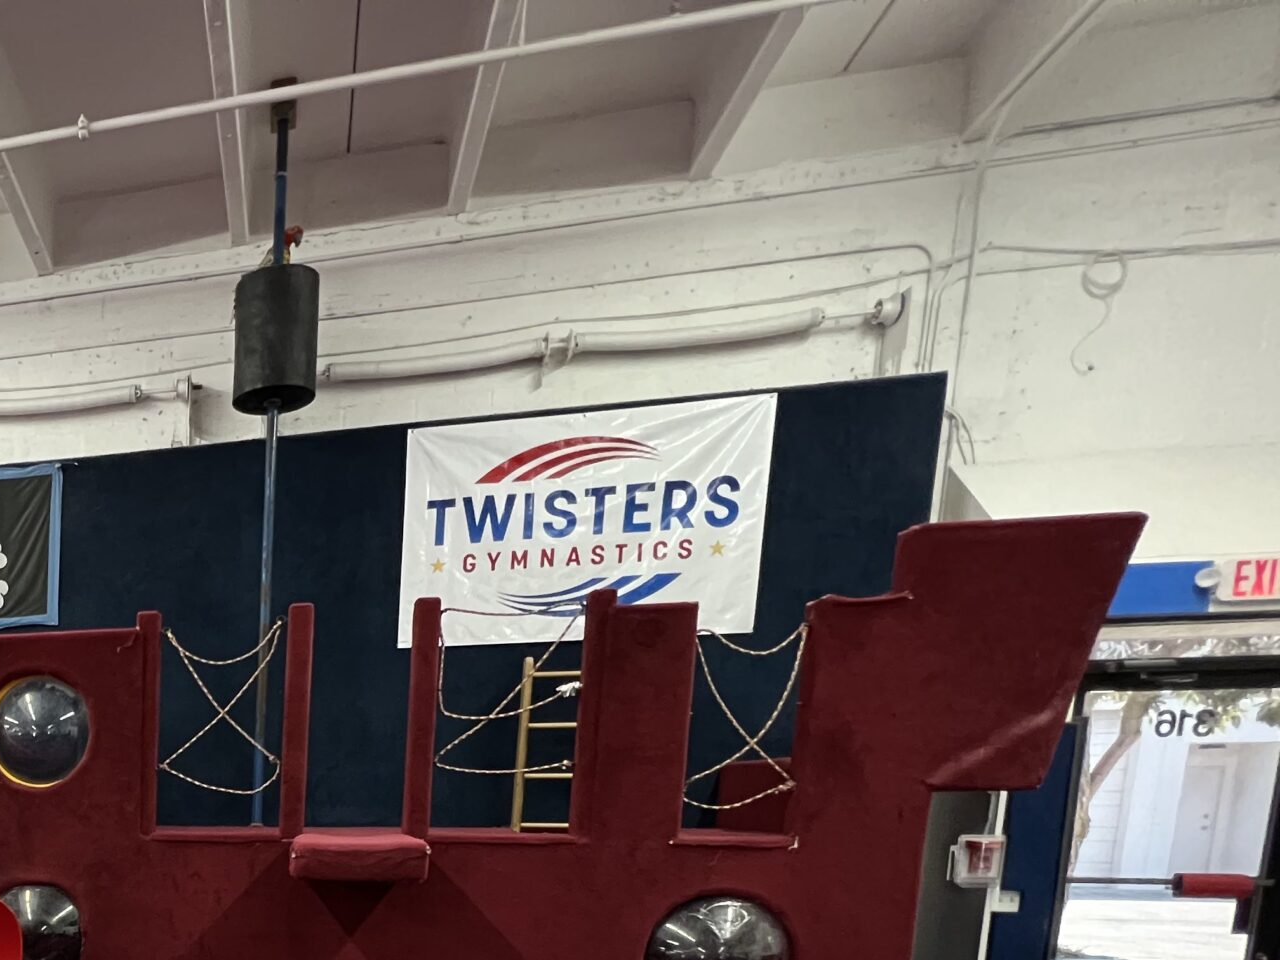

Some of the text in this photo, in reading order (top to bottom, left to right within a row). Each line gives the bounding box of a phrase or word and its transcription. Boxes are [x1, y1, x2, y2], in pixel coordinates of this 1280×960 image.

[426, 475, 741, 546] TWISTERS
[462, 538, 694, 574] GYMNASTICS
[1233, 559, 1280, 597] EXI
